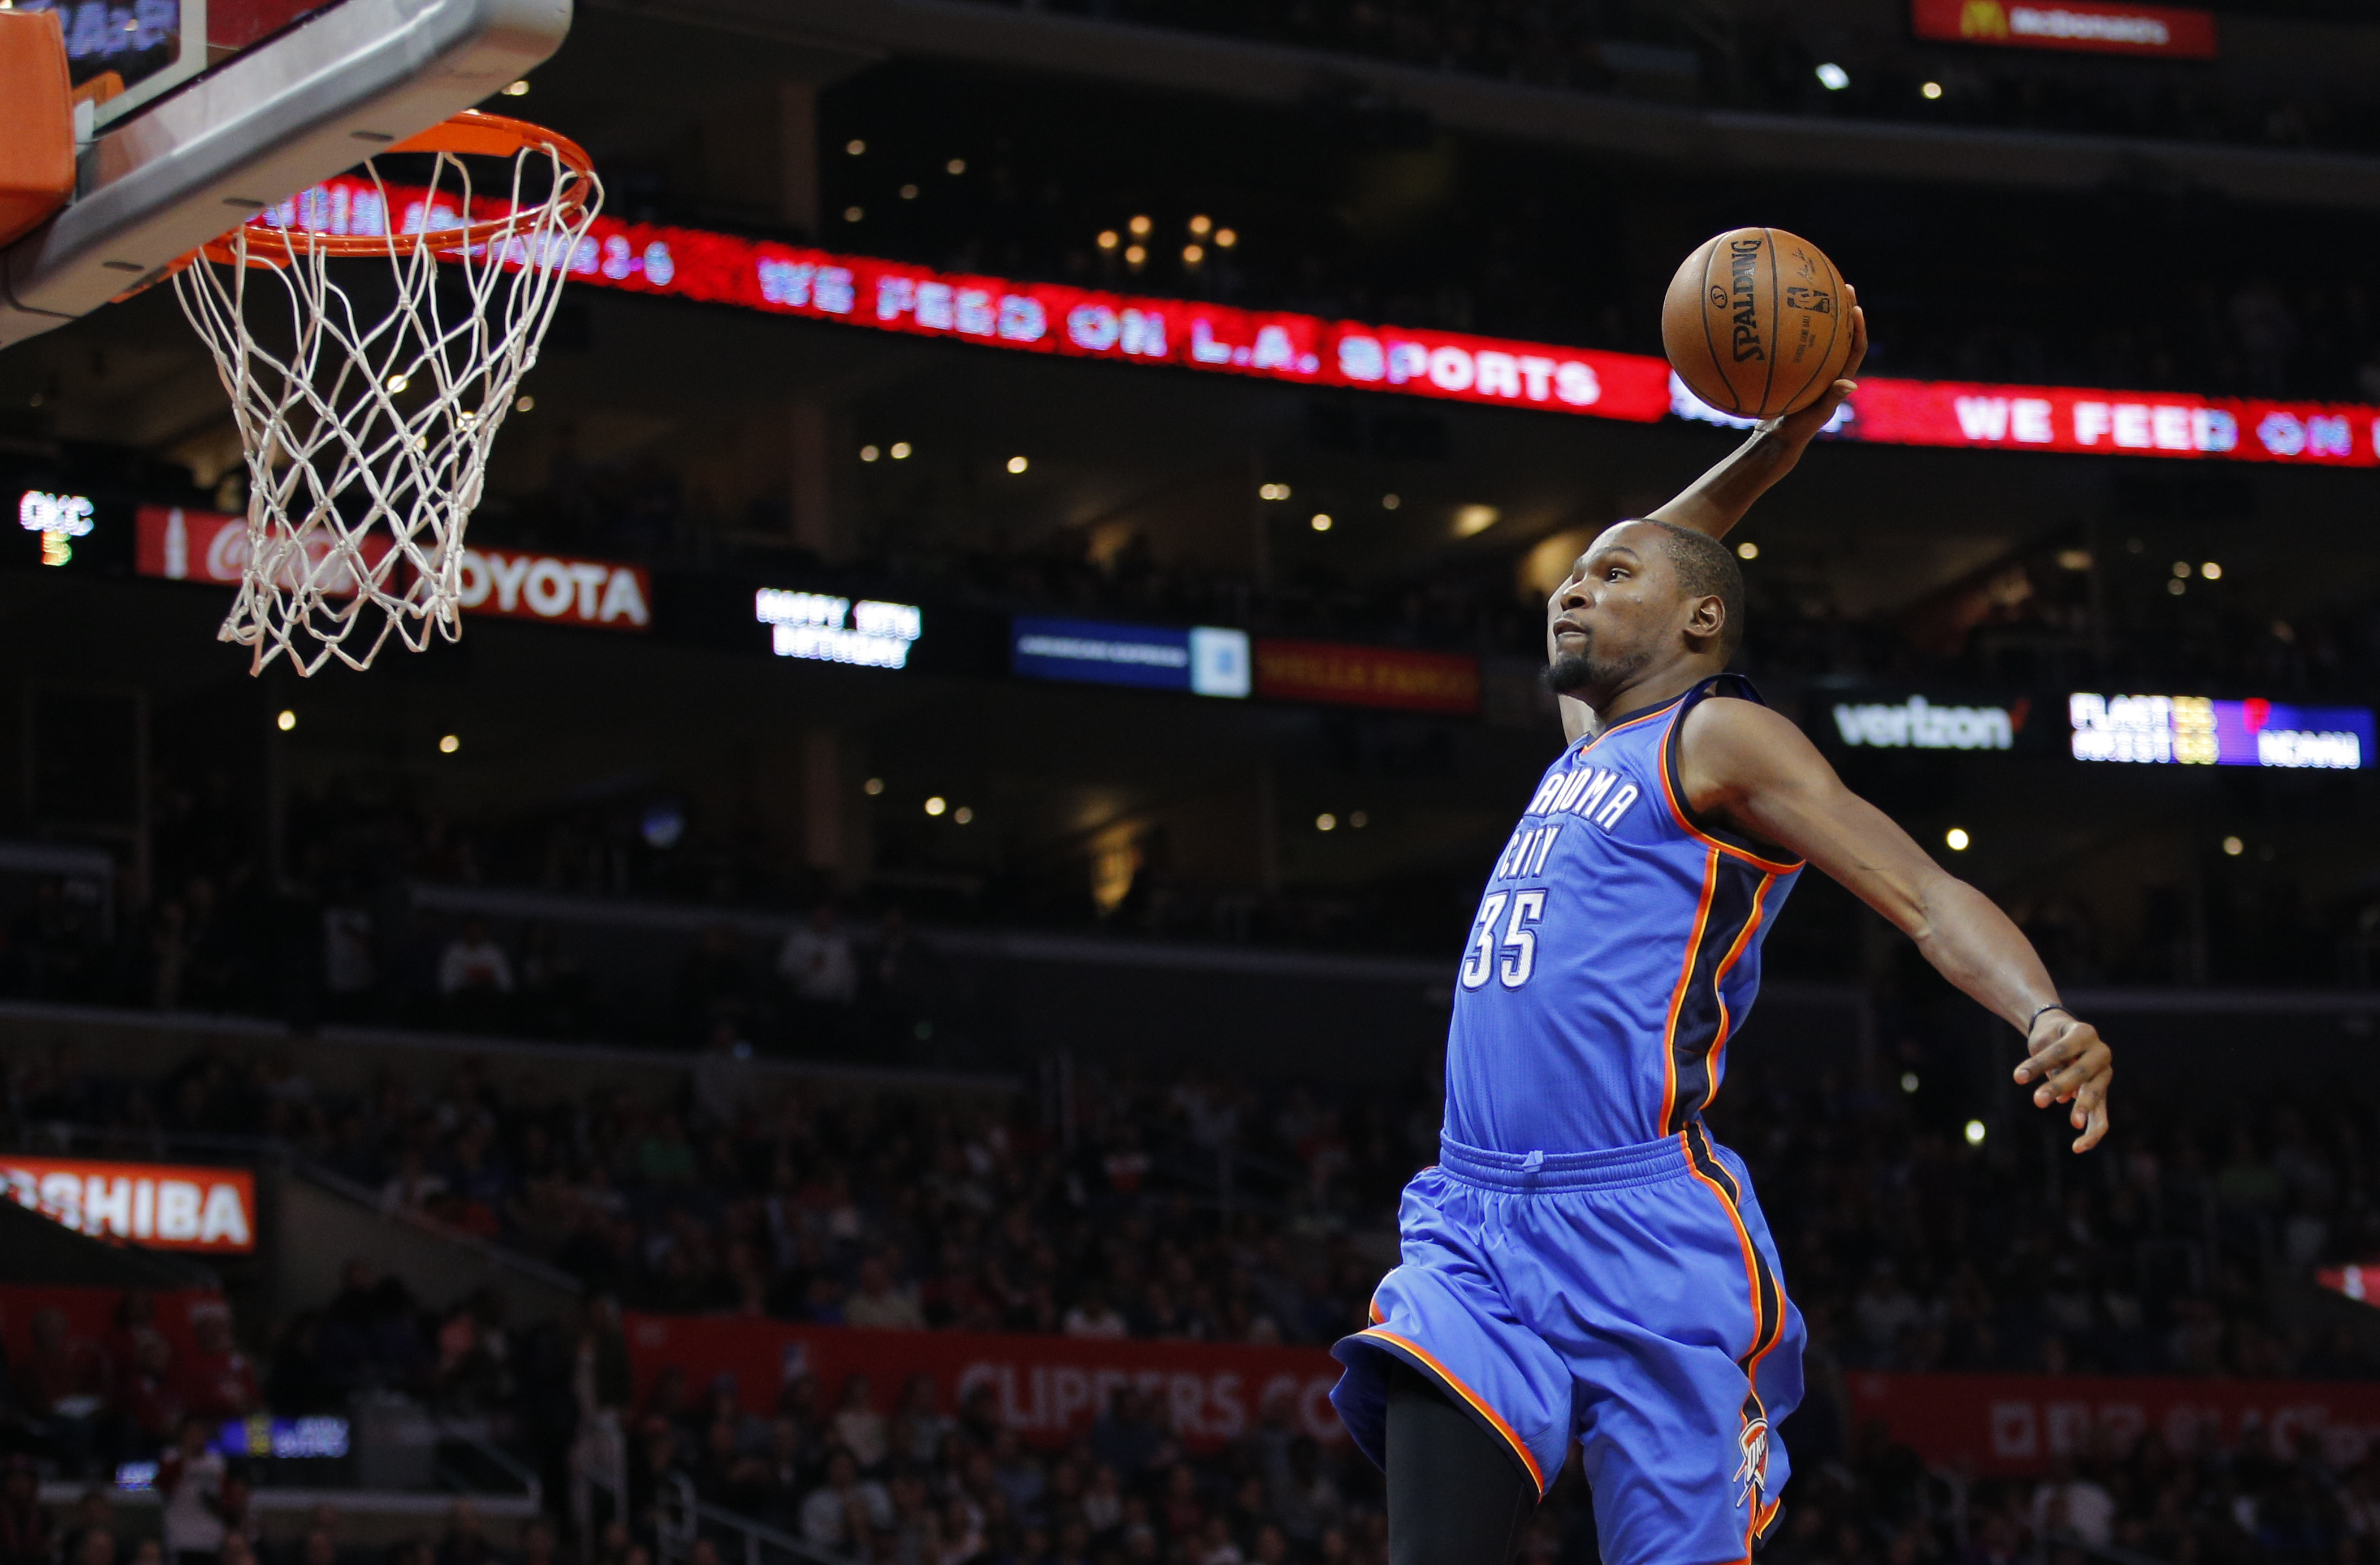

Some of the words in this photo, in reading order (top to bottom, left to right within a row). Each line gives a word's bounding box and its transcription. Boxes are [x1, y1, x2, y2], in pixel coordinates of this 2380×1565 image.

[757, 256, 856, 315] WE
[876, 274, 1046, 343] FEED
[1066, 304, 1168, 357] ON
[1191, 317, 1320, 375] L.A.
[1338, 335, 1601, 406] SPORTS
[1731, 239, 1764, 363] SPALDING
[1954, 395, 2054, 444] WE
[2073, 400, 2239, 453] FEED
[2256, 410, 2352, 457] ON
[19, 490, 95, 537] OKC
[1832, 694, 2014, 750] verizon
[1498, 824, 1563, 882] CITY
[1461, 888, 1549, 992] 35
[0, 1170, 251, 1246] OSHIBA
